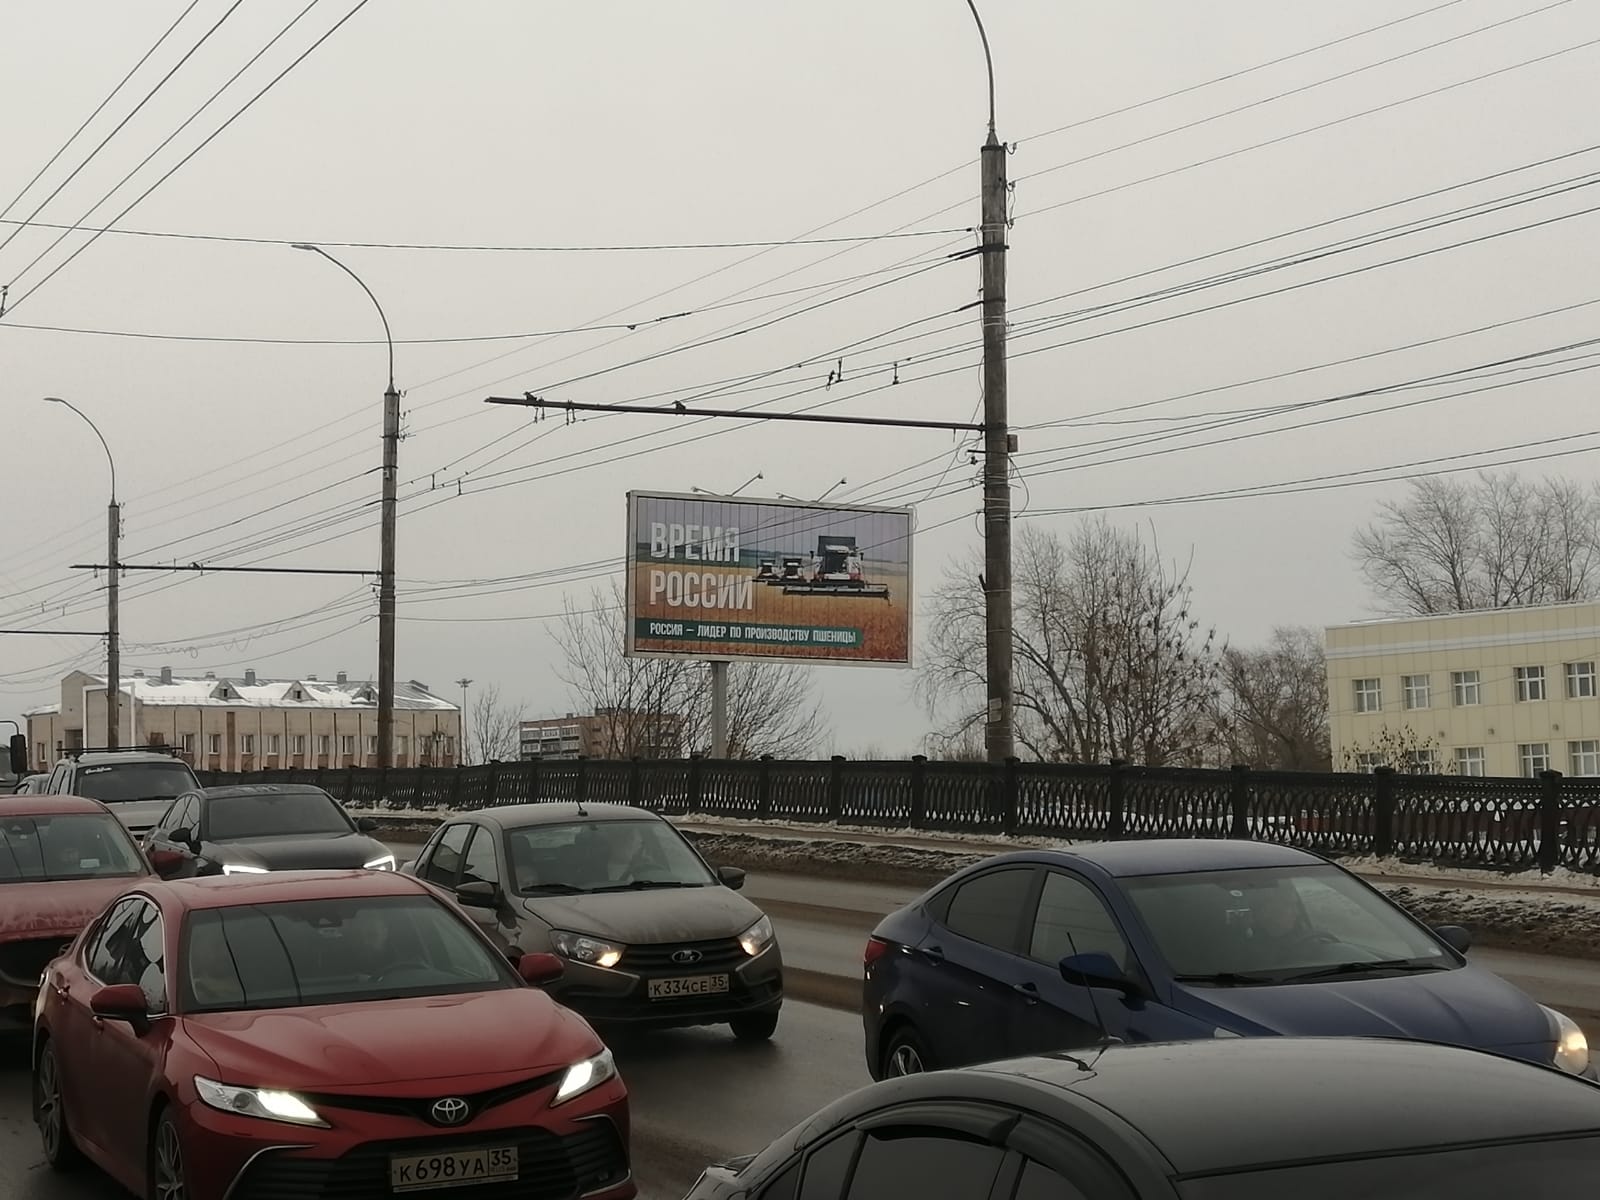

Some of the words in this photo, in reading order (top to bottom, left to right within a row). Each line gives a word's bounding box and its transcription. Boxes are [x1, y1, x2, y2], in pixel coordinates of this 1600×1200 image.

[650, 522, 740, 562] ВРЕМЯ
[650, 570, 753, 610] РОССИИ
[650, 622, 683, 636] РОССИЯ
[697, 624, 727, 637] ЛИДЕР
[730, 625, 741, 638] ПО
[745, 626, 809, 642] ПРОИЗВОДСТВУ
[812, 629, 856, 644] ПШЕНИЦЫ
[711, 975, 724, 987] 35
[491, 1149, 511, 1166] 35
